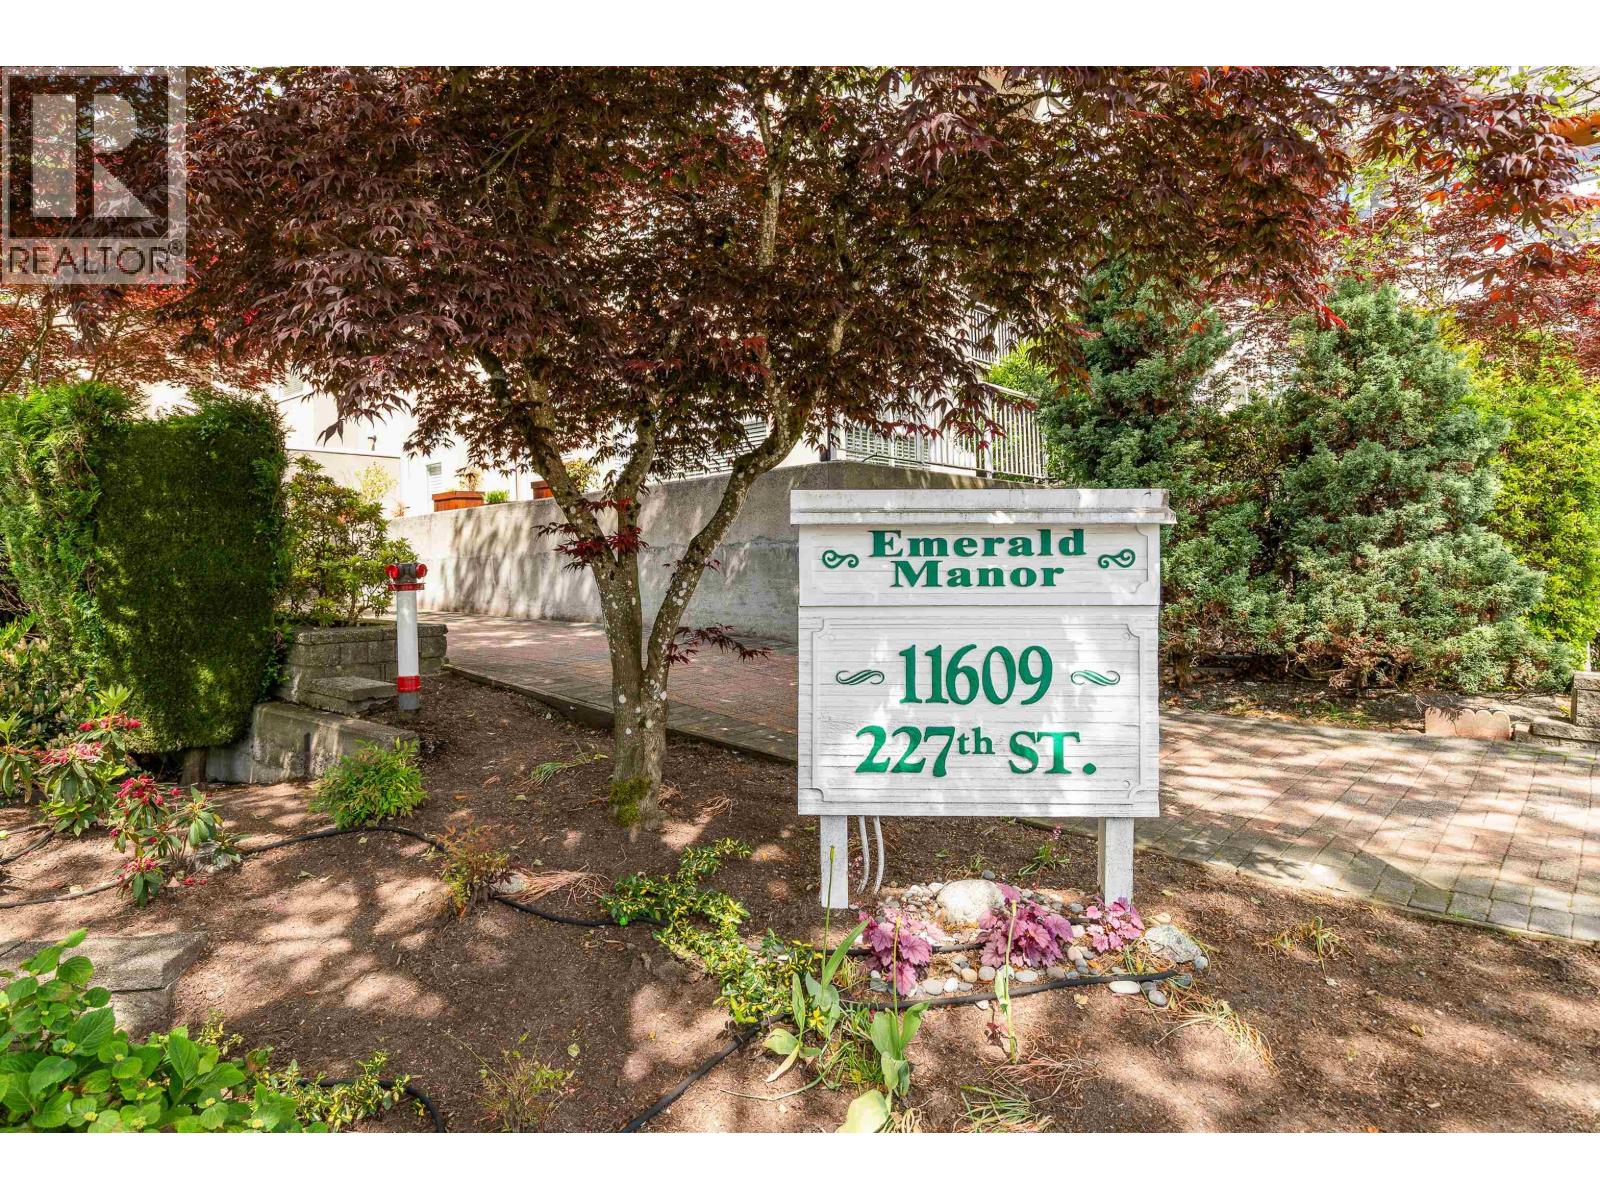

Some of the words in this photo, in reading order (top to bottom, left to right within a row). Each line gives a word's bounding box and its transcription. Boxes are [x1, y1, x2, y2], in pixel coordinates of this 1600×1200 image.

[868, 528, 1087, 558] Emerald
[890, 560, 1066, 589] Manor
[898, 642, 1054, 707] 11609
[854, 724, 997, 779] 227th
[1008, 729, 1098, 776] ST.
